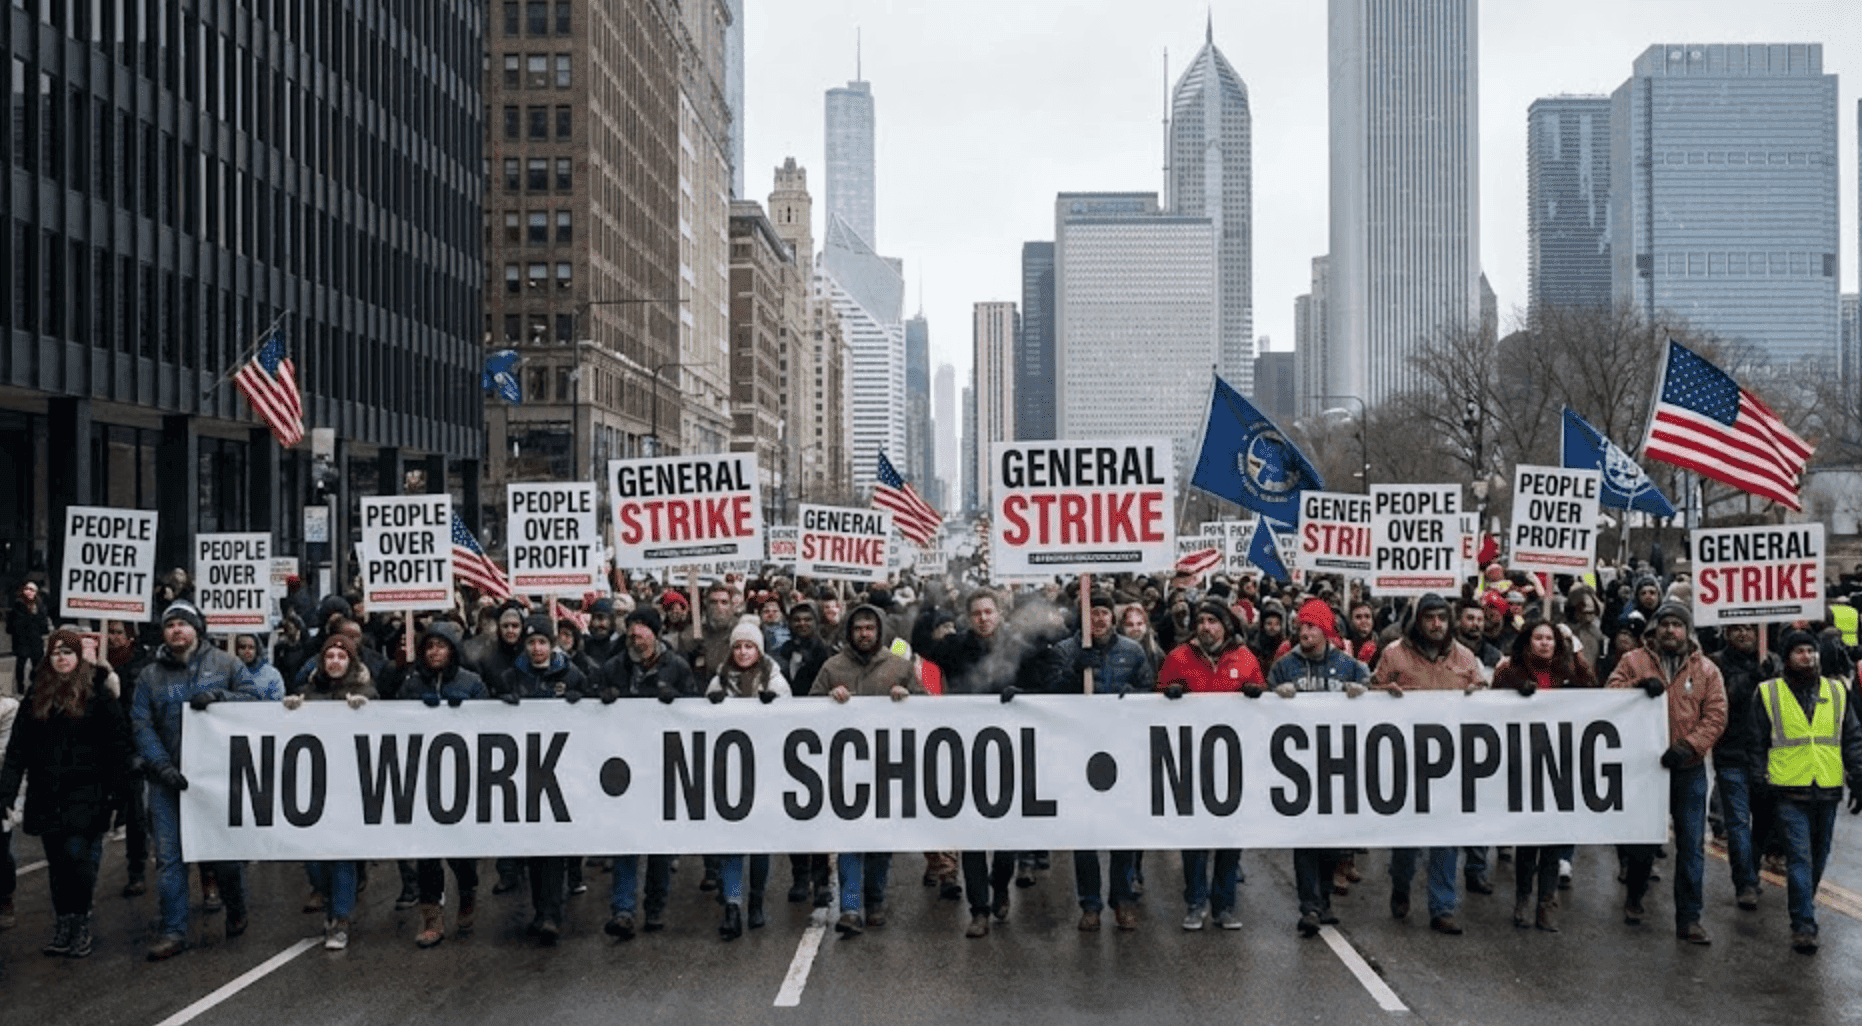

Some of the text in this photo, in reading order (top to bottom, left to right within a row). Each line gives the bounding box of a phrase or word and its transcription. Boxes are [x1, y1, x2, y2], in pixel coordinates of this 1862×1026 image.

[618, 460, 750, 497] GENERAL
[1002, 447, 1164, 488] GENERAL
[1520, 473, 1595, 499] PEOPLE
[513, 491, 590, 513] PEOPLE
[1376, 492, 1455, 514] PEOPLE
[1530, 500, 1581, 523] OVER
[72, 515, 150, 540] PEOPLE
[367, 504, 446, 527] PEOPLE
[621, 496, 753, 544] STRIKE
[804, 510, 886, 535] GENERAL
[1004, 492, 1164, 545] STRIKE
[525, 518, 578, 541] OVER
[1388, 520, 1443, 542] OVER
[1516, 525, 1590, 550] PROFIT
[82, 542, 136, 567] OVER
[200, 541, 265, 560] PEOPLE
[380, 531, 434, 554] OVER
[802, 534, 884, 566] STRIKE
[1699, 532, 1816, 562] GENERAL
[515, 545, 590, 568] PROFIT
[1377, 547, 1454, 570] PROFIT
[68, 569, 146, 594] PROFIT
[210, 565, 255, 584] OVER
[370, 559, 446, 584] PROFIT
[1700, 564, 1816, 604] STRIKE
[201, 589, 264, 609] PROFIT
[228, 720, 1623, 827] NO WORK NO SCHOOL NO SHOPPING
